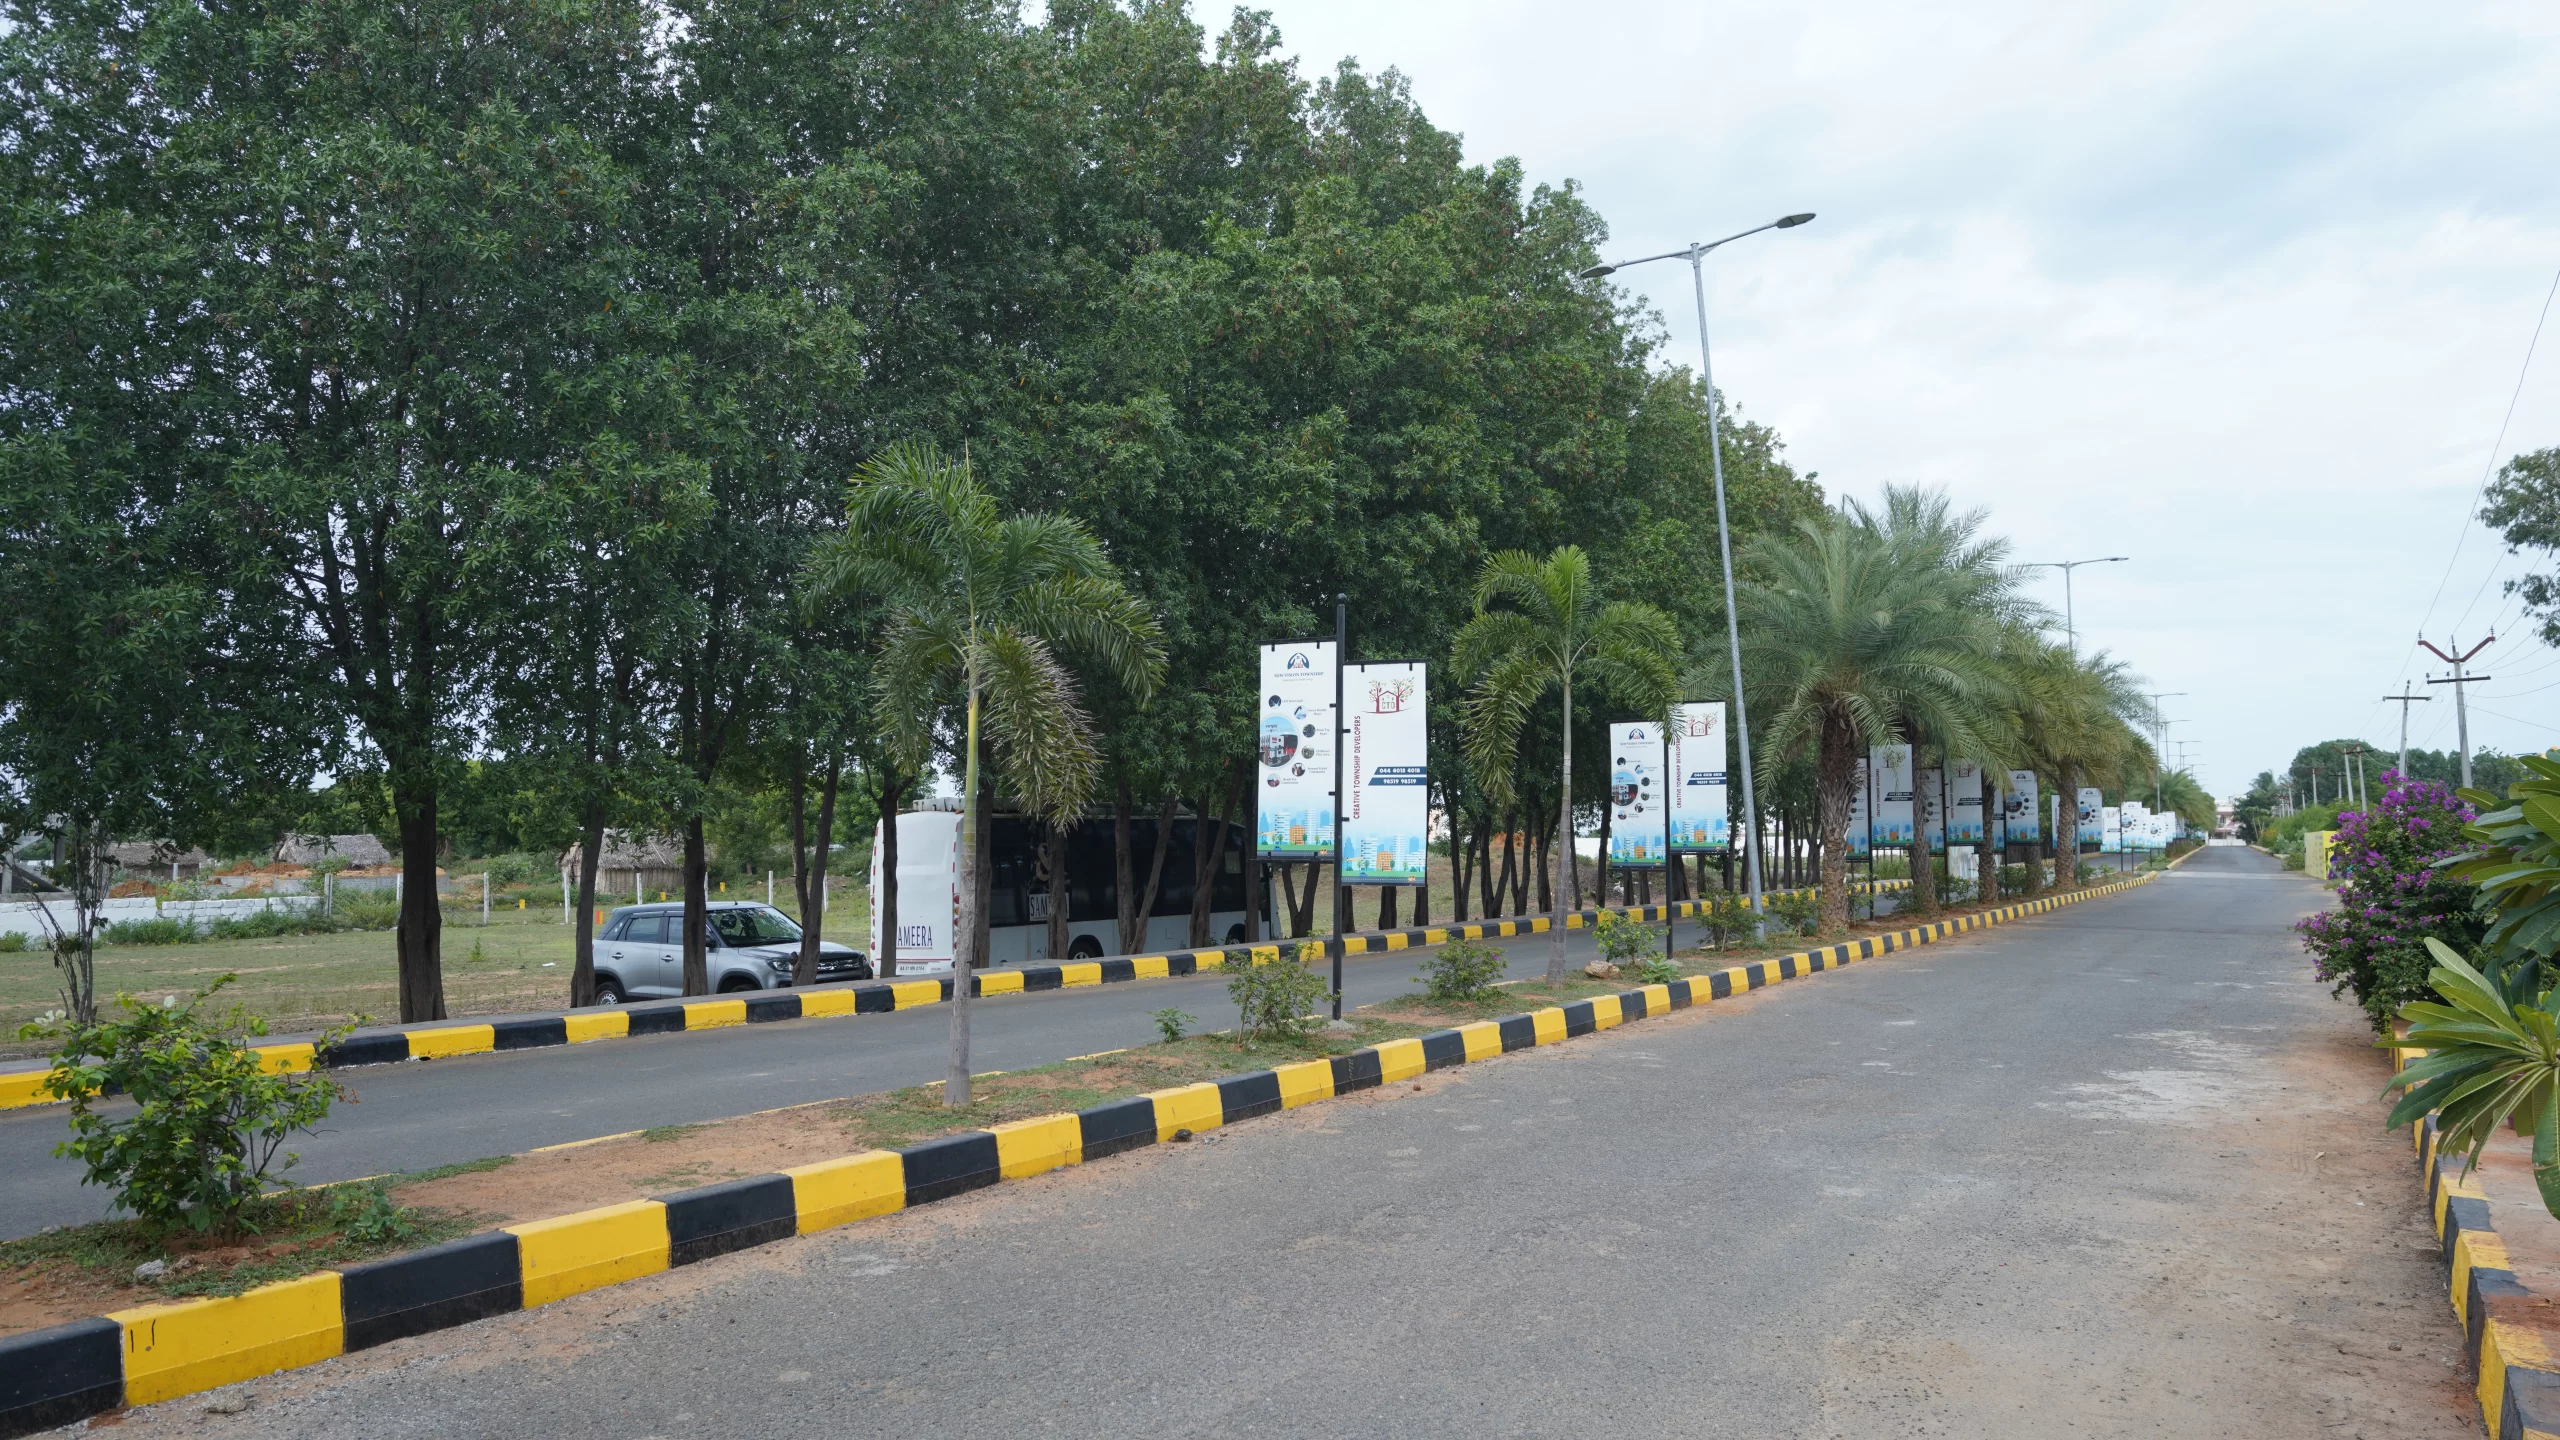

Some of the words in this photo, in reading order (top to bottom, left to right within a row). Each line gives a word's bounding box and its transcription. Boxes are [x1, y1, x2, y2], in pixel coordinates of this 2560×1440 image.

[1353, 755, 1361, 788] TOWNSHIP
[1353, 790, 1361, 819] CREATIVE
[897, 926, 933, 946] AMEERA
